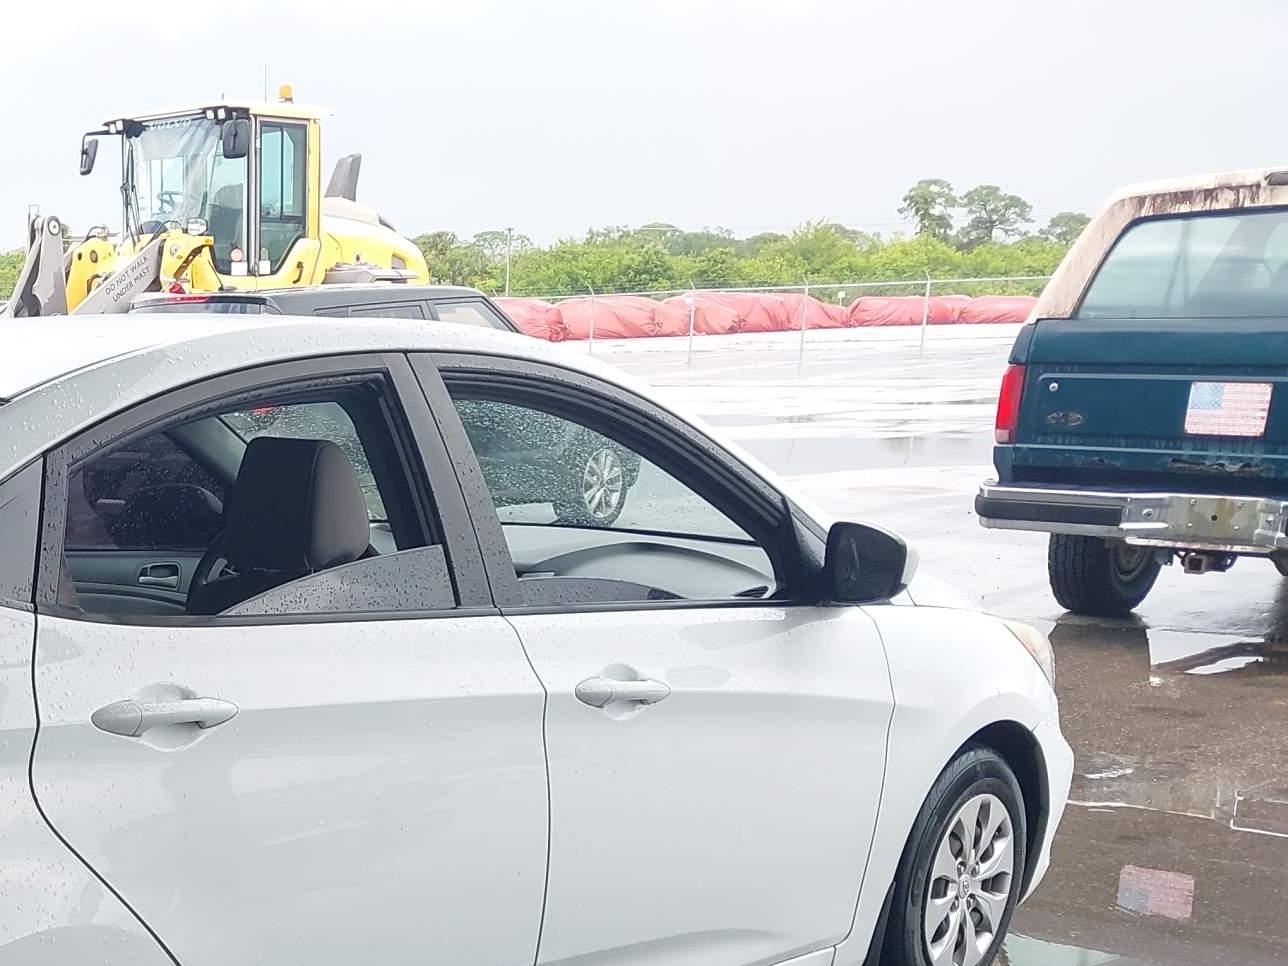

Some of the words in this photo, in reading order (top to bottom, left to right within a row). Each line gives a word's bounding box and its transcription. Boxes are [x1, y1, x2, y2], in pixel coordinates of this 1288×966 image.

[105, 283, 116, 295] DO
[116, 270, 130, 286] NOT
[130, 255, 148, 273] WALK
[112, 280, 134, 302] UNDER
[133, 266, 150, 284] MAST
